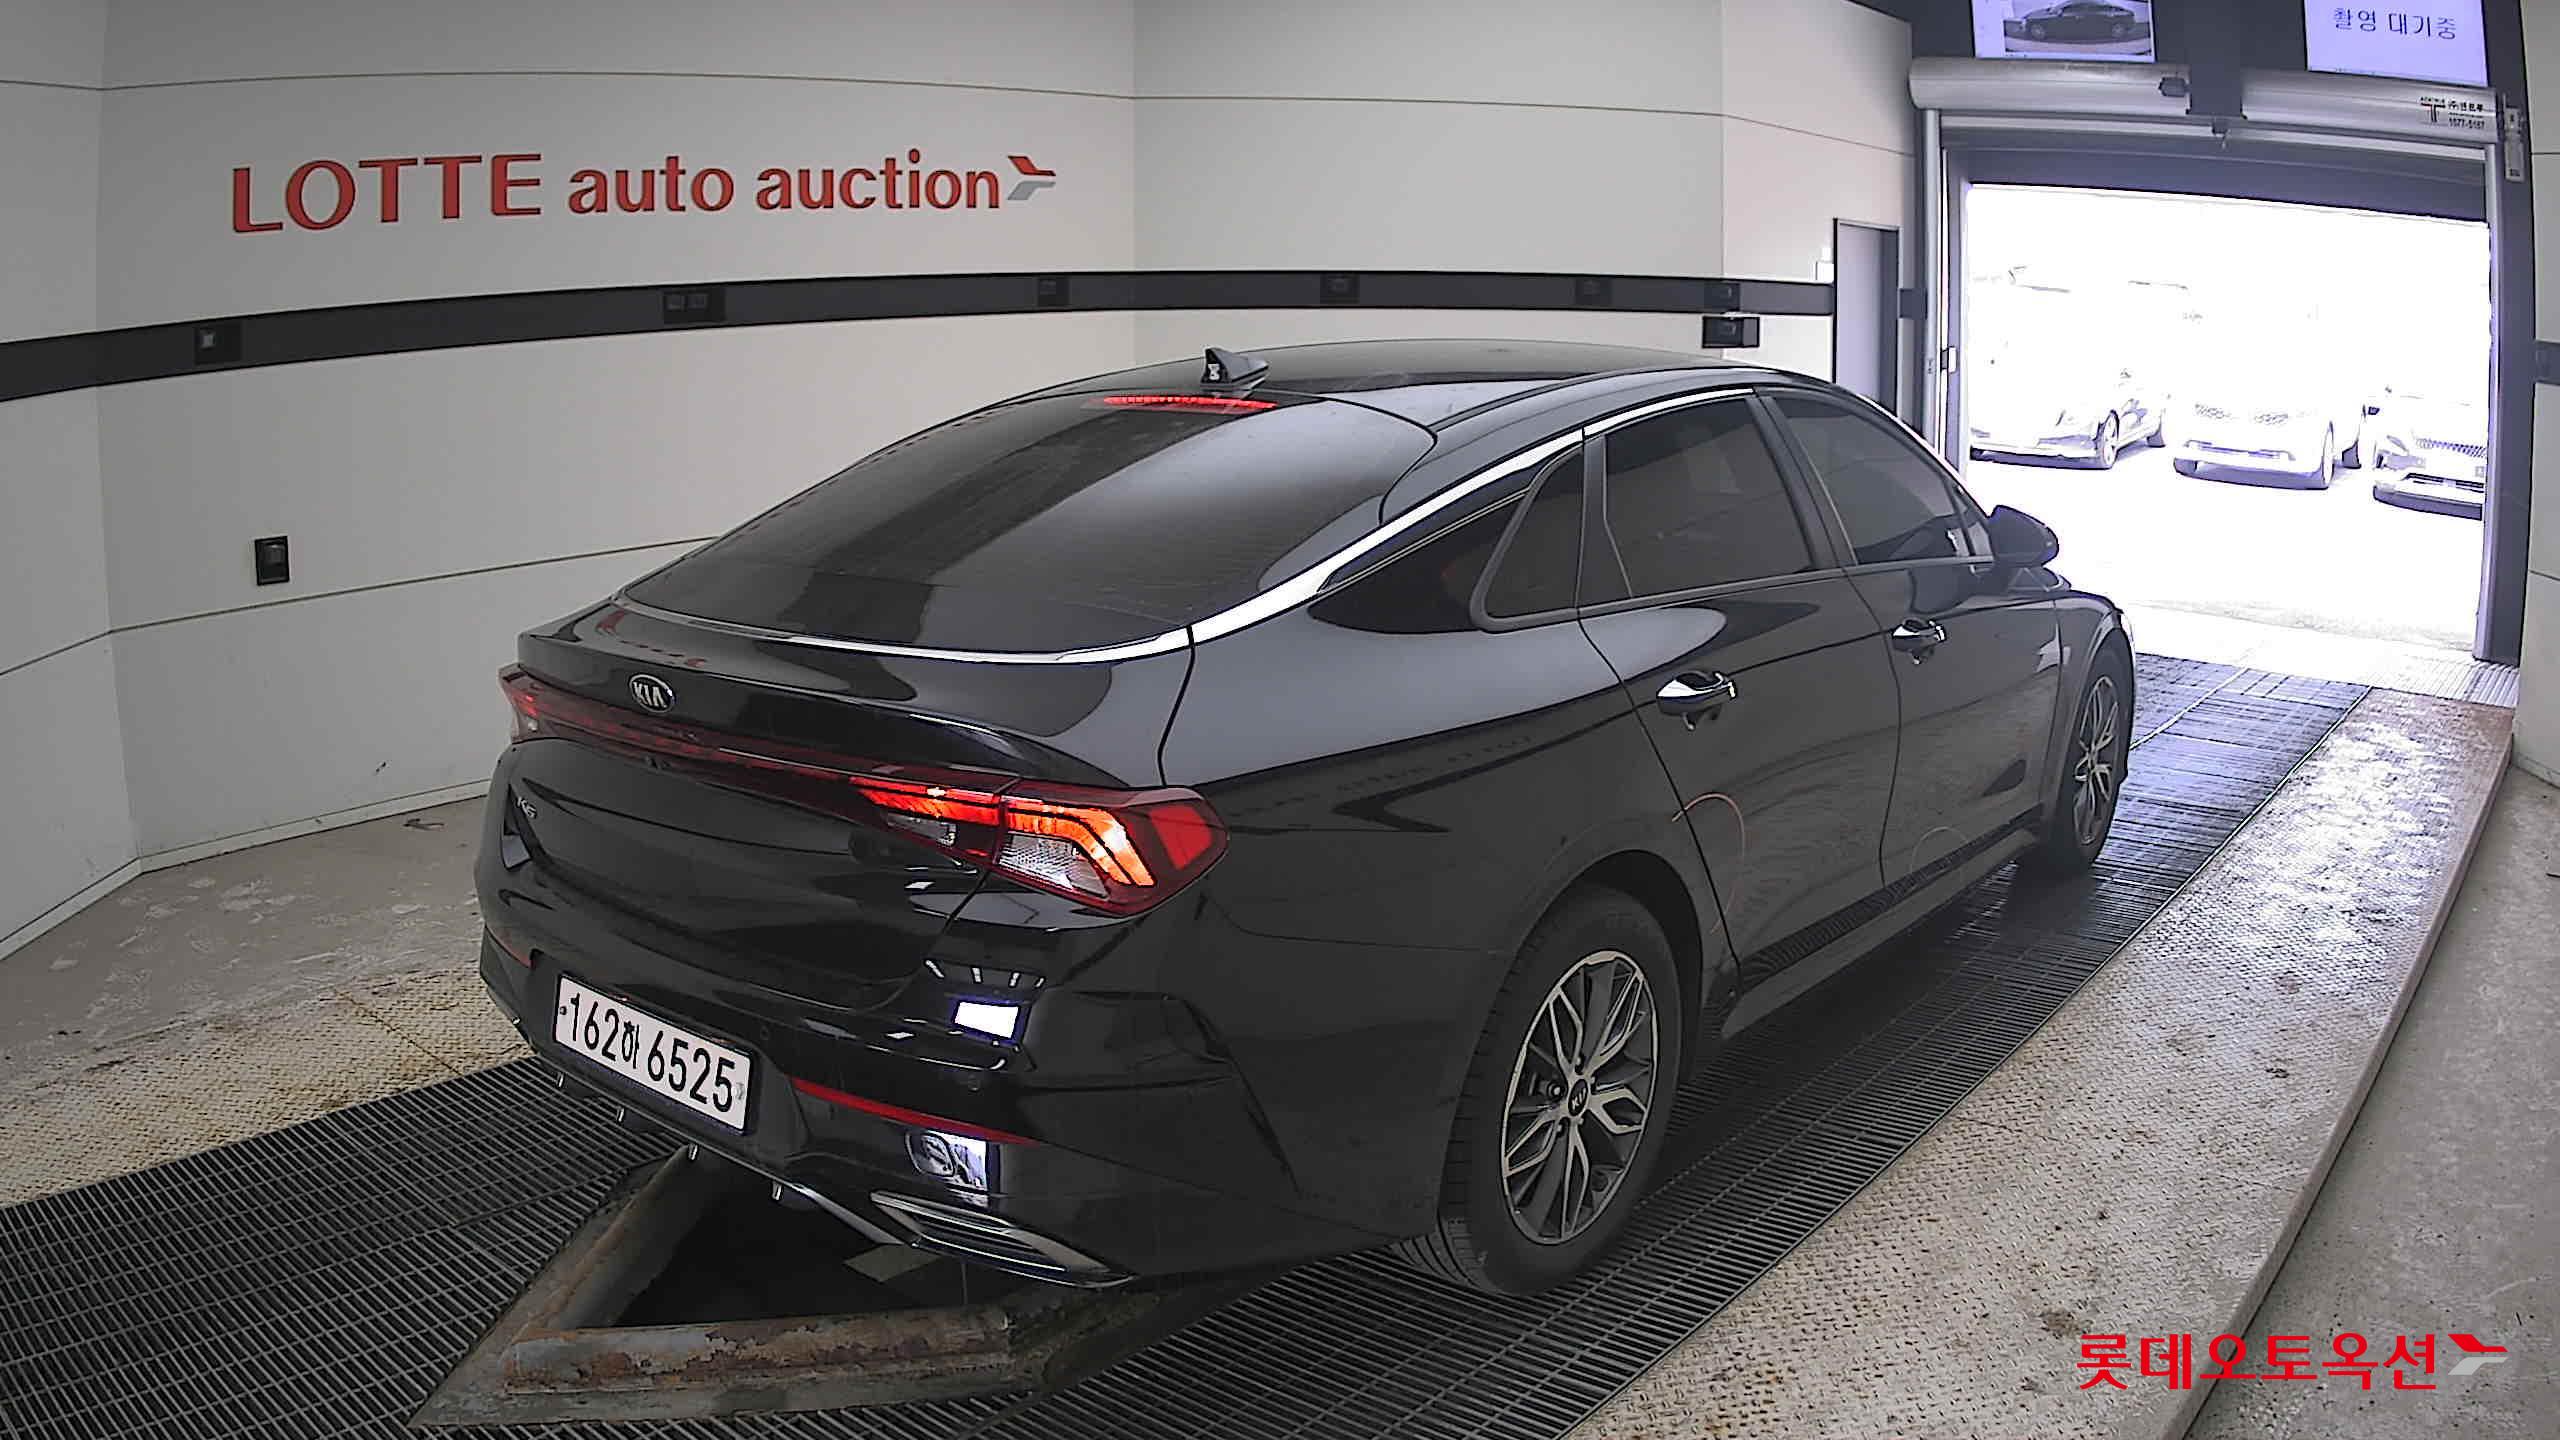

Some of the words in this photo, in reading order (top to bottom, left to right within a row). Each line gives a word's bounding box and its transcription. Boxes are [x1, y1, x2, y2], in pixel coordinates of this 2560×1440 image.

[2334, 8, 2377, 32] 촬영
[2388, 13, 2456, 40] 대기중
[232, 154, 542, 234] LOTTE
[568, 155, 735, 215] auto
[756, 148, 1001, 210] auction
[632, 681, 668, 709] KIA
[647, 1030, 736, 1113] 6525
